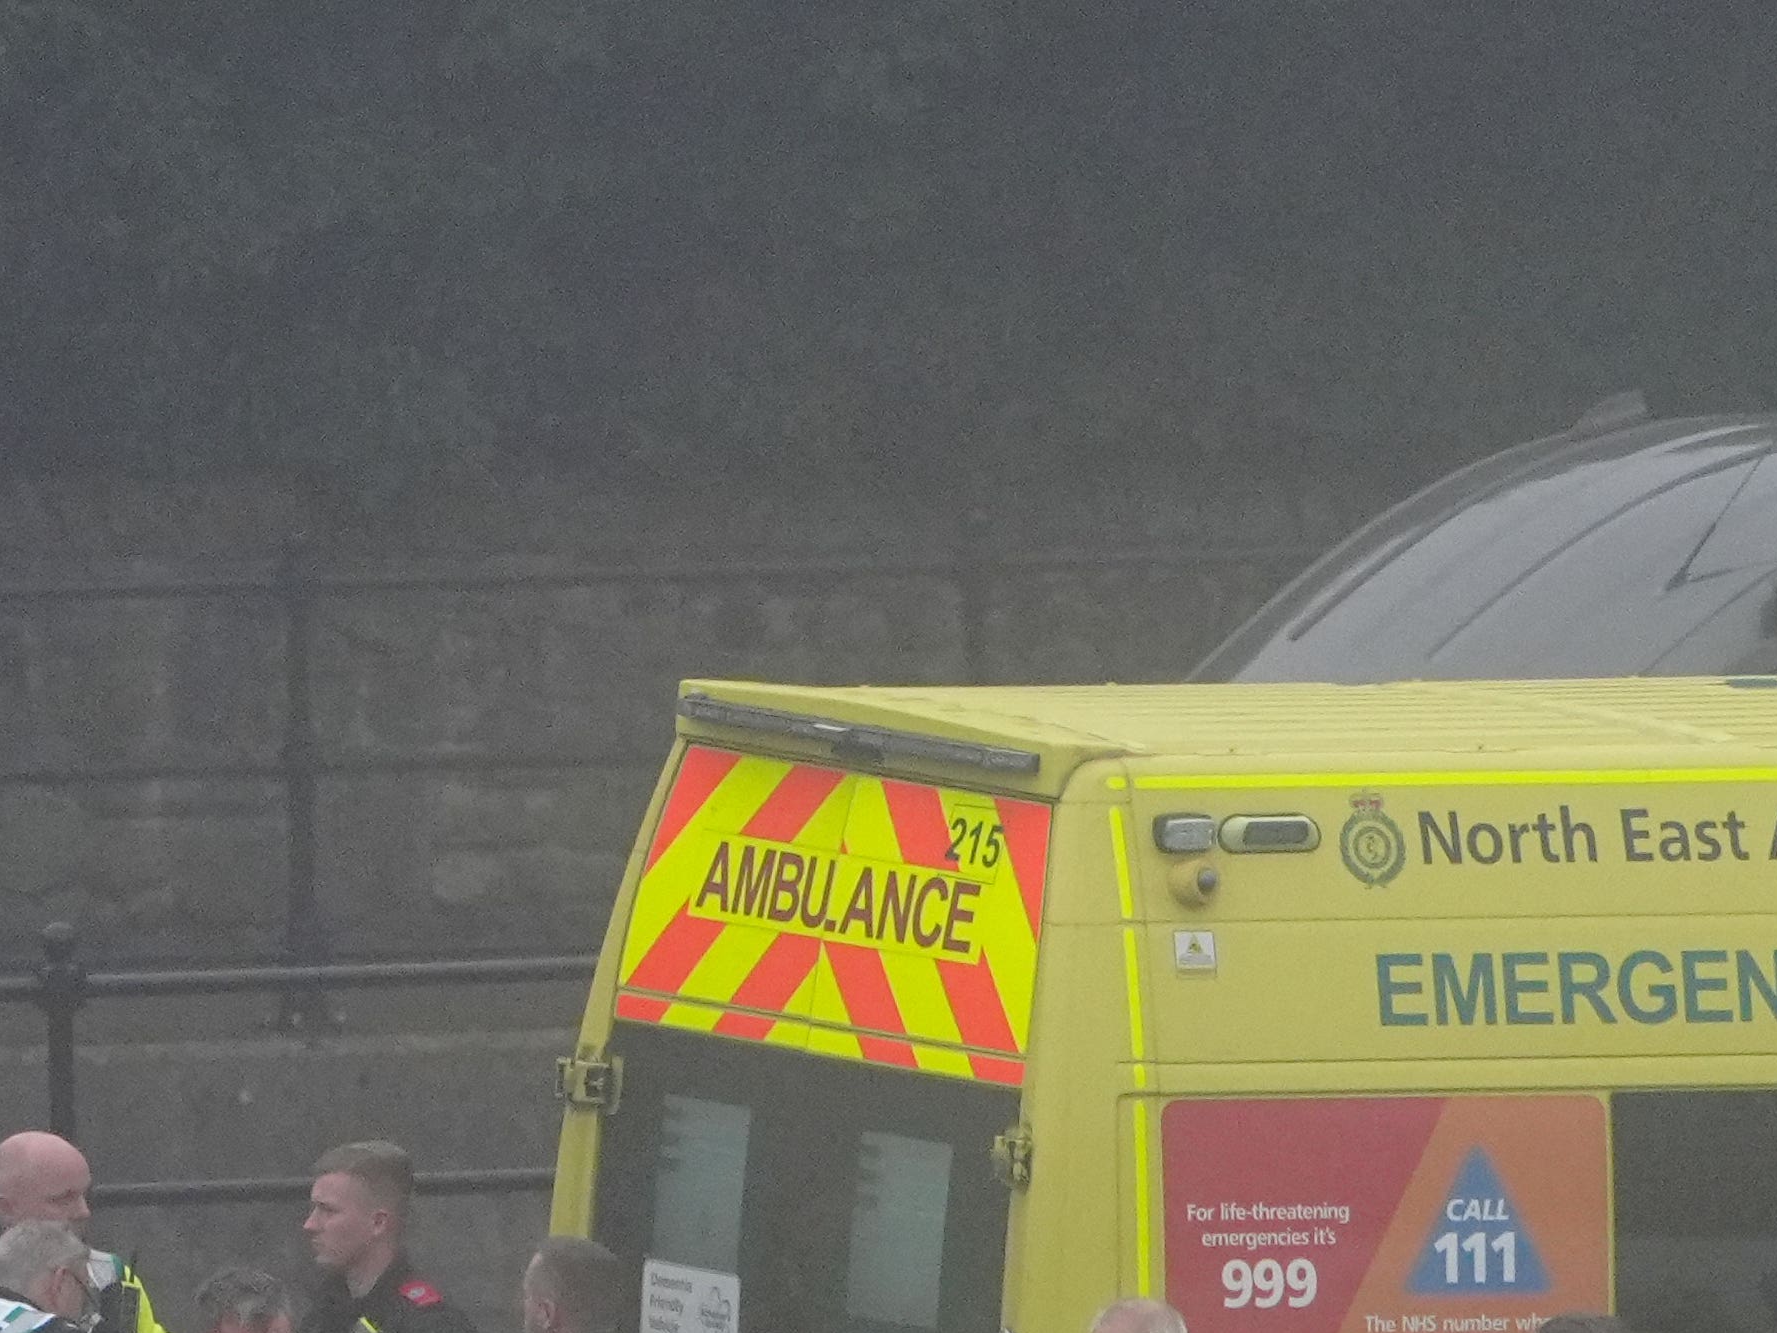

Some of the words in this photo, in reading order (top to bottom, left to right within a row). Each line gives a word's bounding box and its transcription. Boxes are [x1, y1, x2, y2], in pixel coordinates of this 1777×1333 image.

[945, 817, 1005, 869] 215
[1417, 805, 1599, 865] North
[1619, 808, 1751, 863] East
[695, 840, 982, 954] AMBULANCE
[1186, 1203, 1216, 1222] For
[1220, 1202, 1350, 1225] life-threatening
[1446, 1198, 1511, 1223] CALL
[1201, 1228, 1310, 1248] emergencies
[1313, 1227, 1337, 1246] it's
[1433, 1231, 1517, 1285] 111
[1222, 1257, 1318, 1309] 999
[1365, 1314, 1397, 1333] The
[1402, 1314, 1437, 1333] NHS
[1443, 1313, 1509, 1333] number
